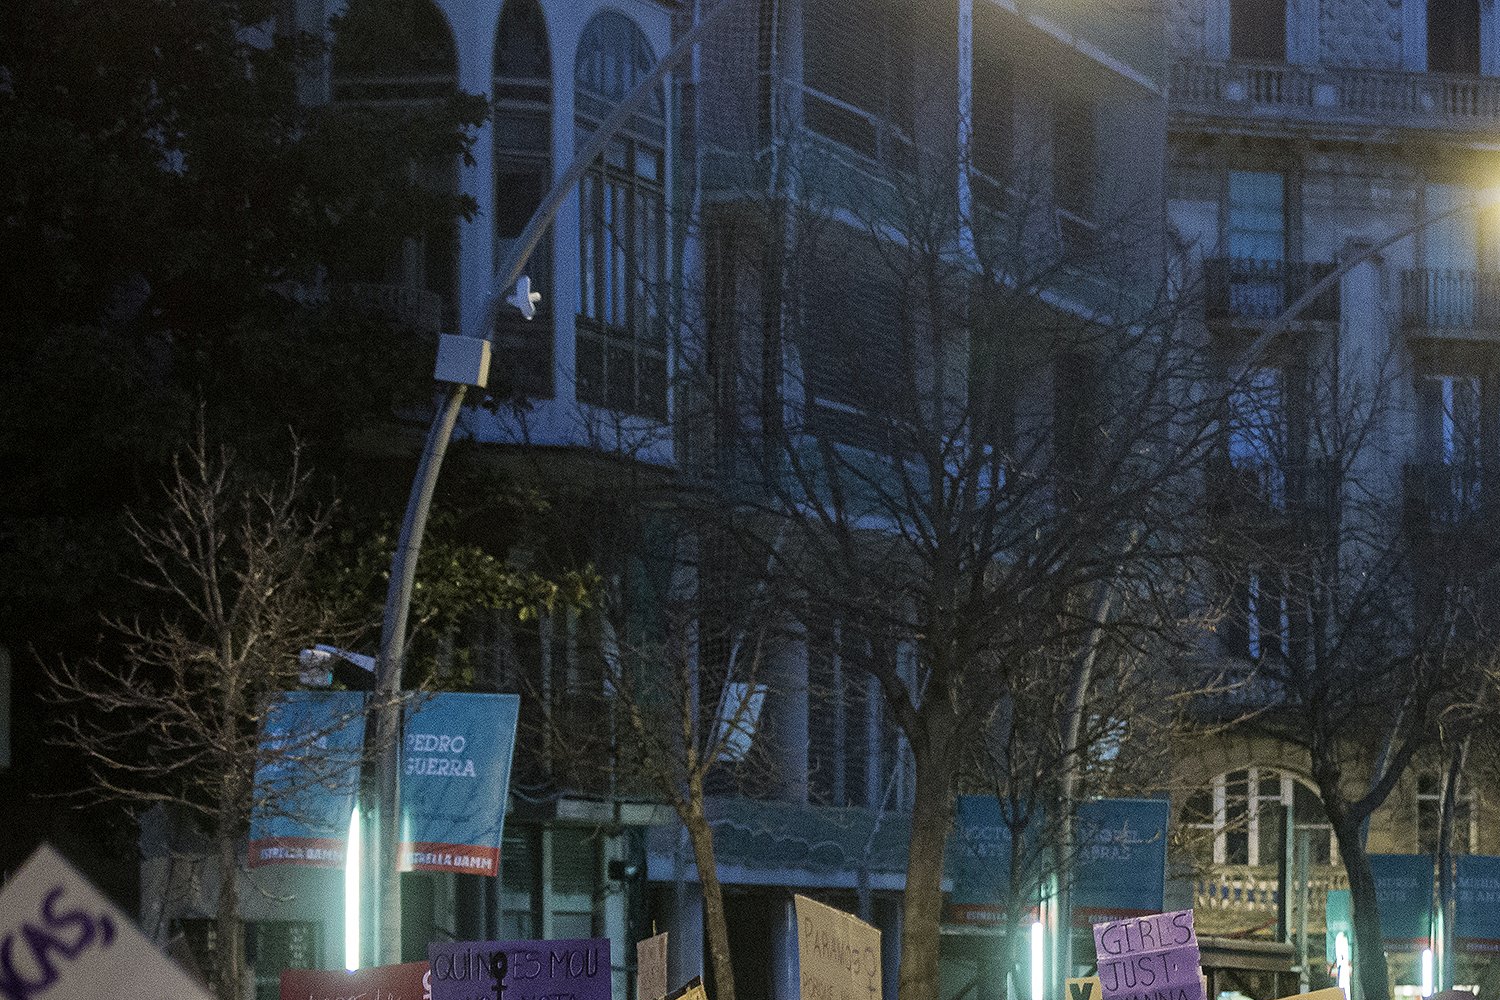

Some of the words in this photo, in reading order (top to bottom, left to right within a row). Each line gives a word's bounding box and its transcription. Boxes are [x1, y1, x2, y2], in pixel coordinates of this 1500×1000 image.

[405, 733, 466, 754] PEDRO
[405, 757, 477, 778] GUERRA
[1101, 912, 1192, 955] GIRLS
[550, 947, 599, 979] MOU
[1105, 953, 1171, 992] JUST
